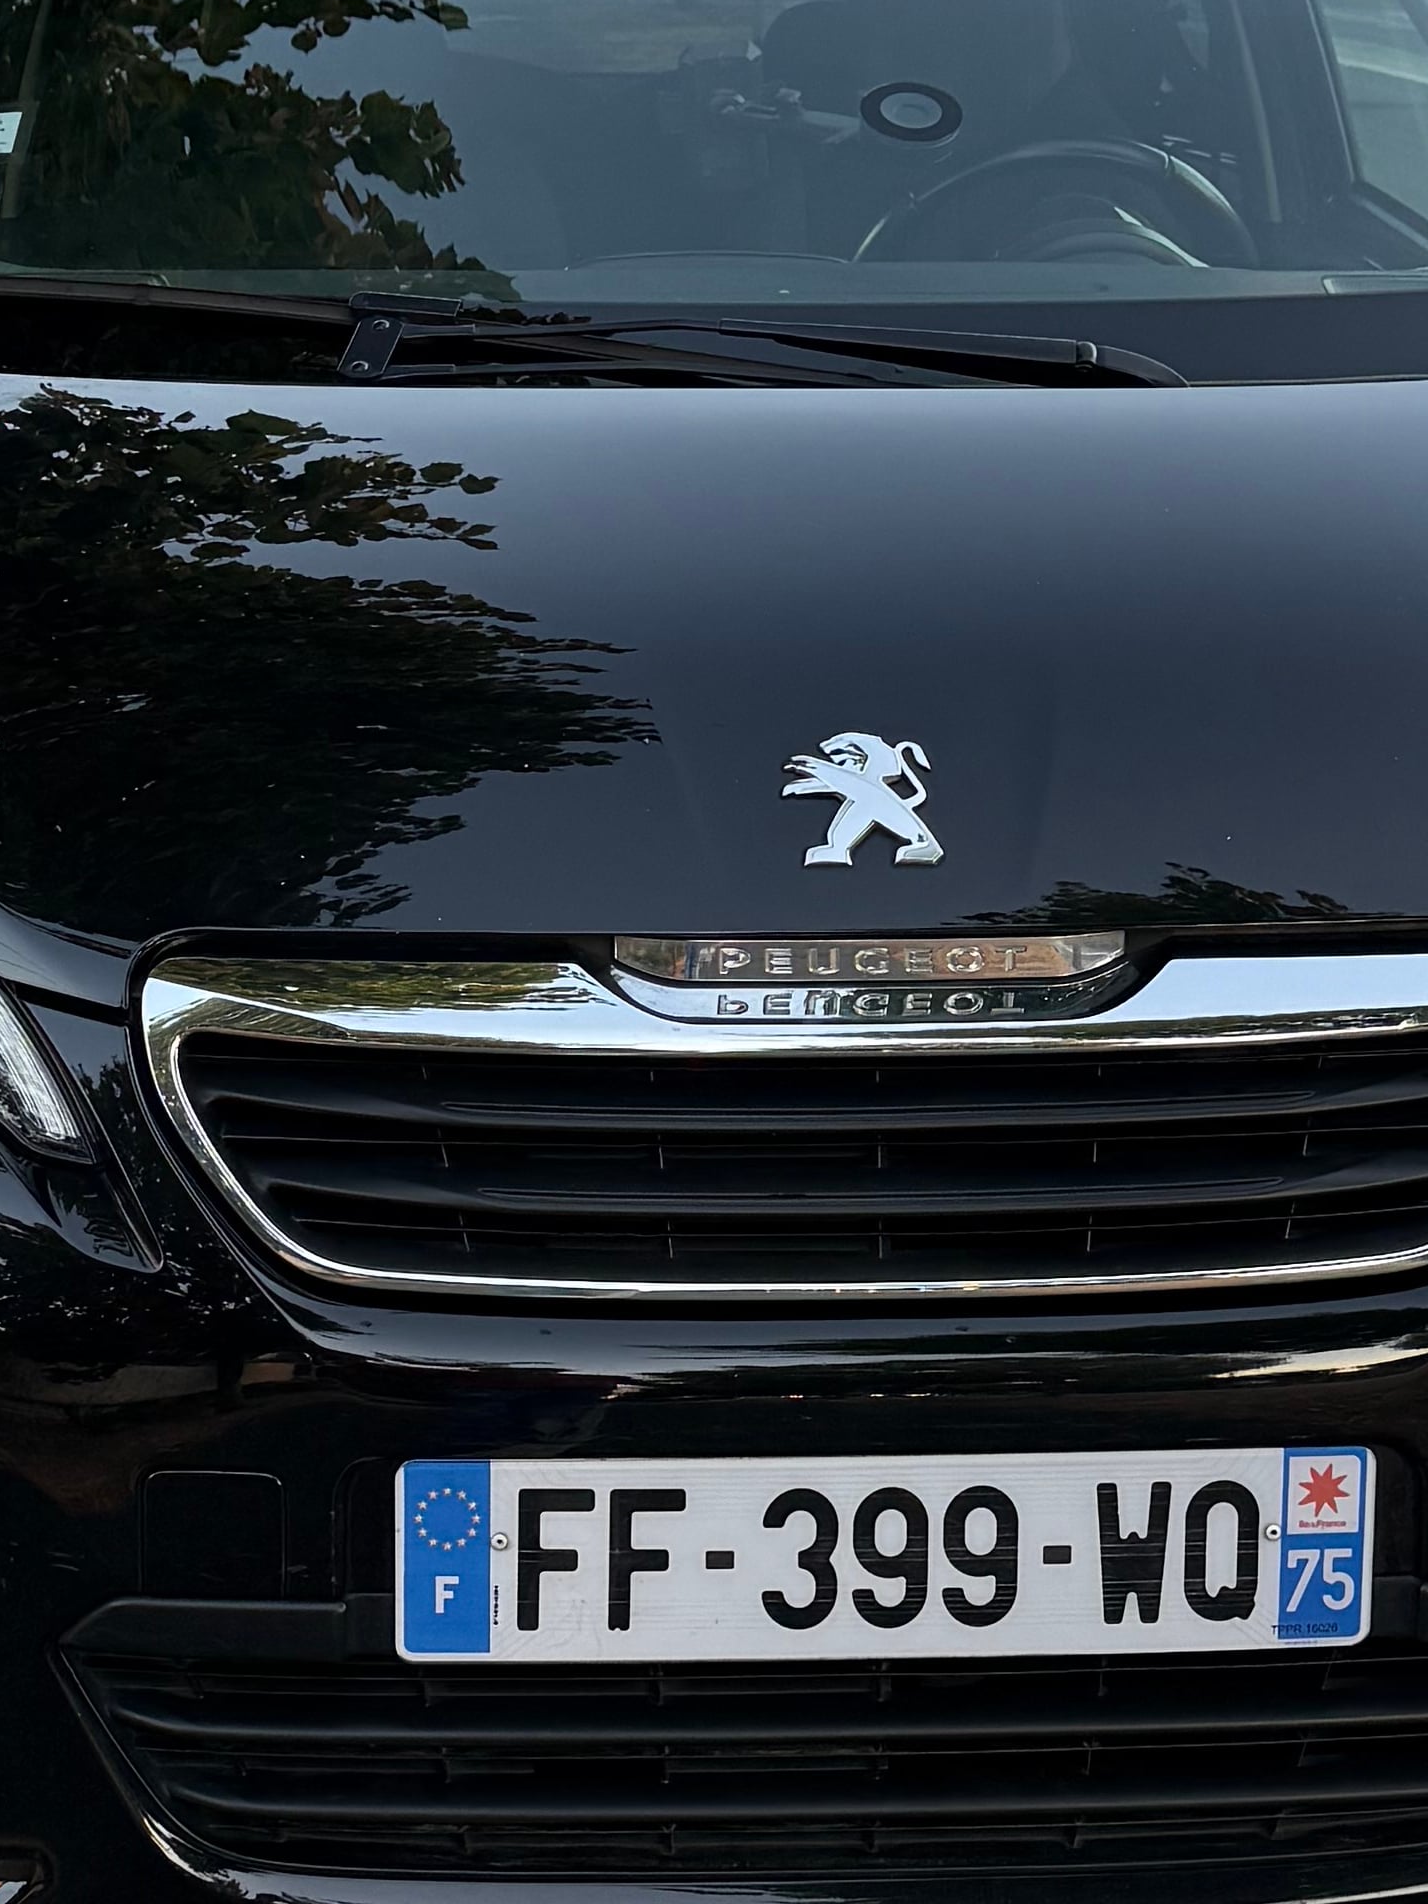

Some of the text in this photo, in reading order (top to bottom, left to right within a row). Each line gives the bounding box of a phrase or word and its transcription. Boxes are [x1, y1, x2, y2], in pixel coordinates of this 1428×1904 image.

[718, 945, 1028, 976] PEUGEOT
[516, 1480, 1260, 1633] FF-399-WQ
[1285, 1547, 1355, 1613] 75
[434, 1575, 460, 1614] F
